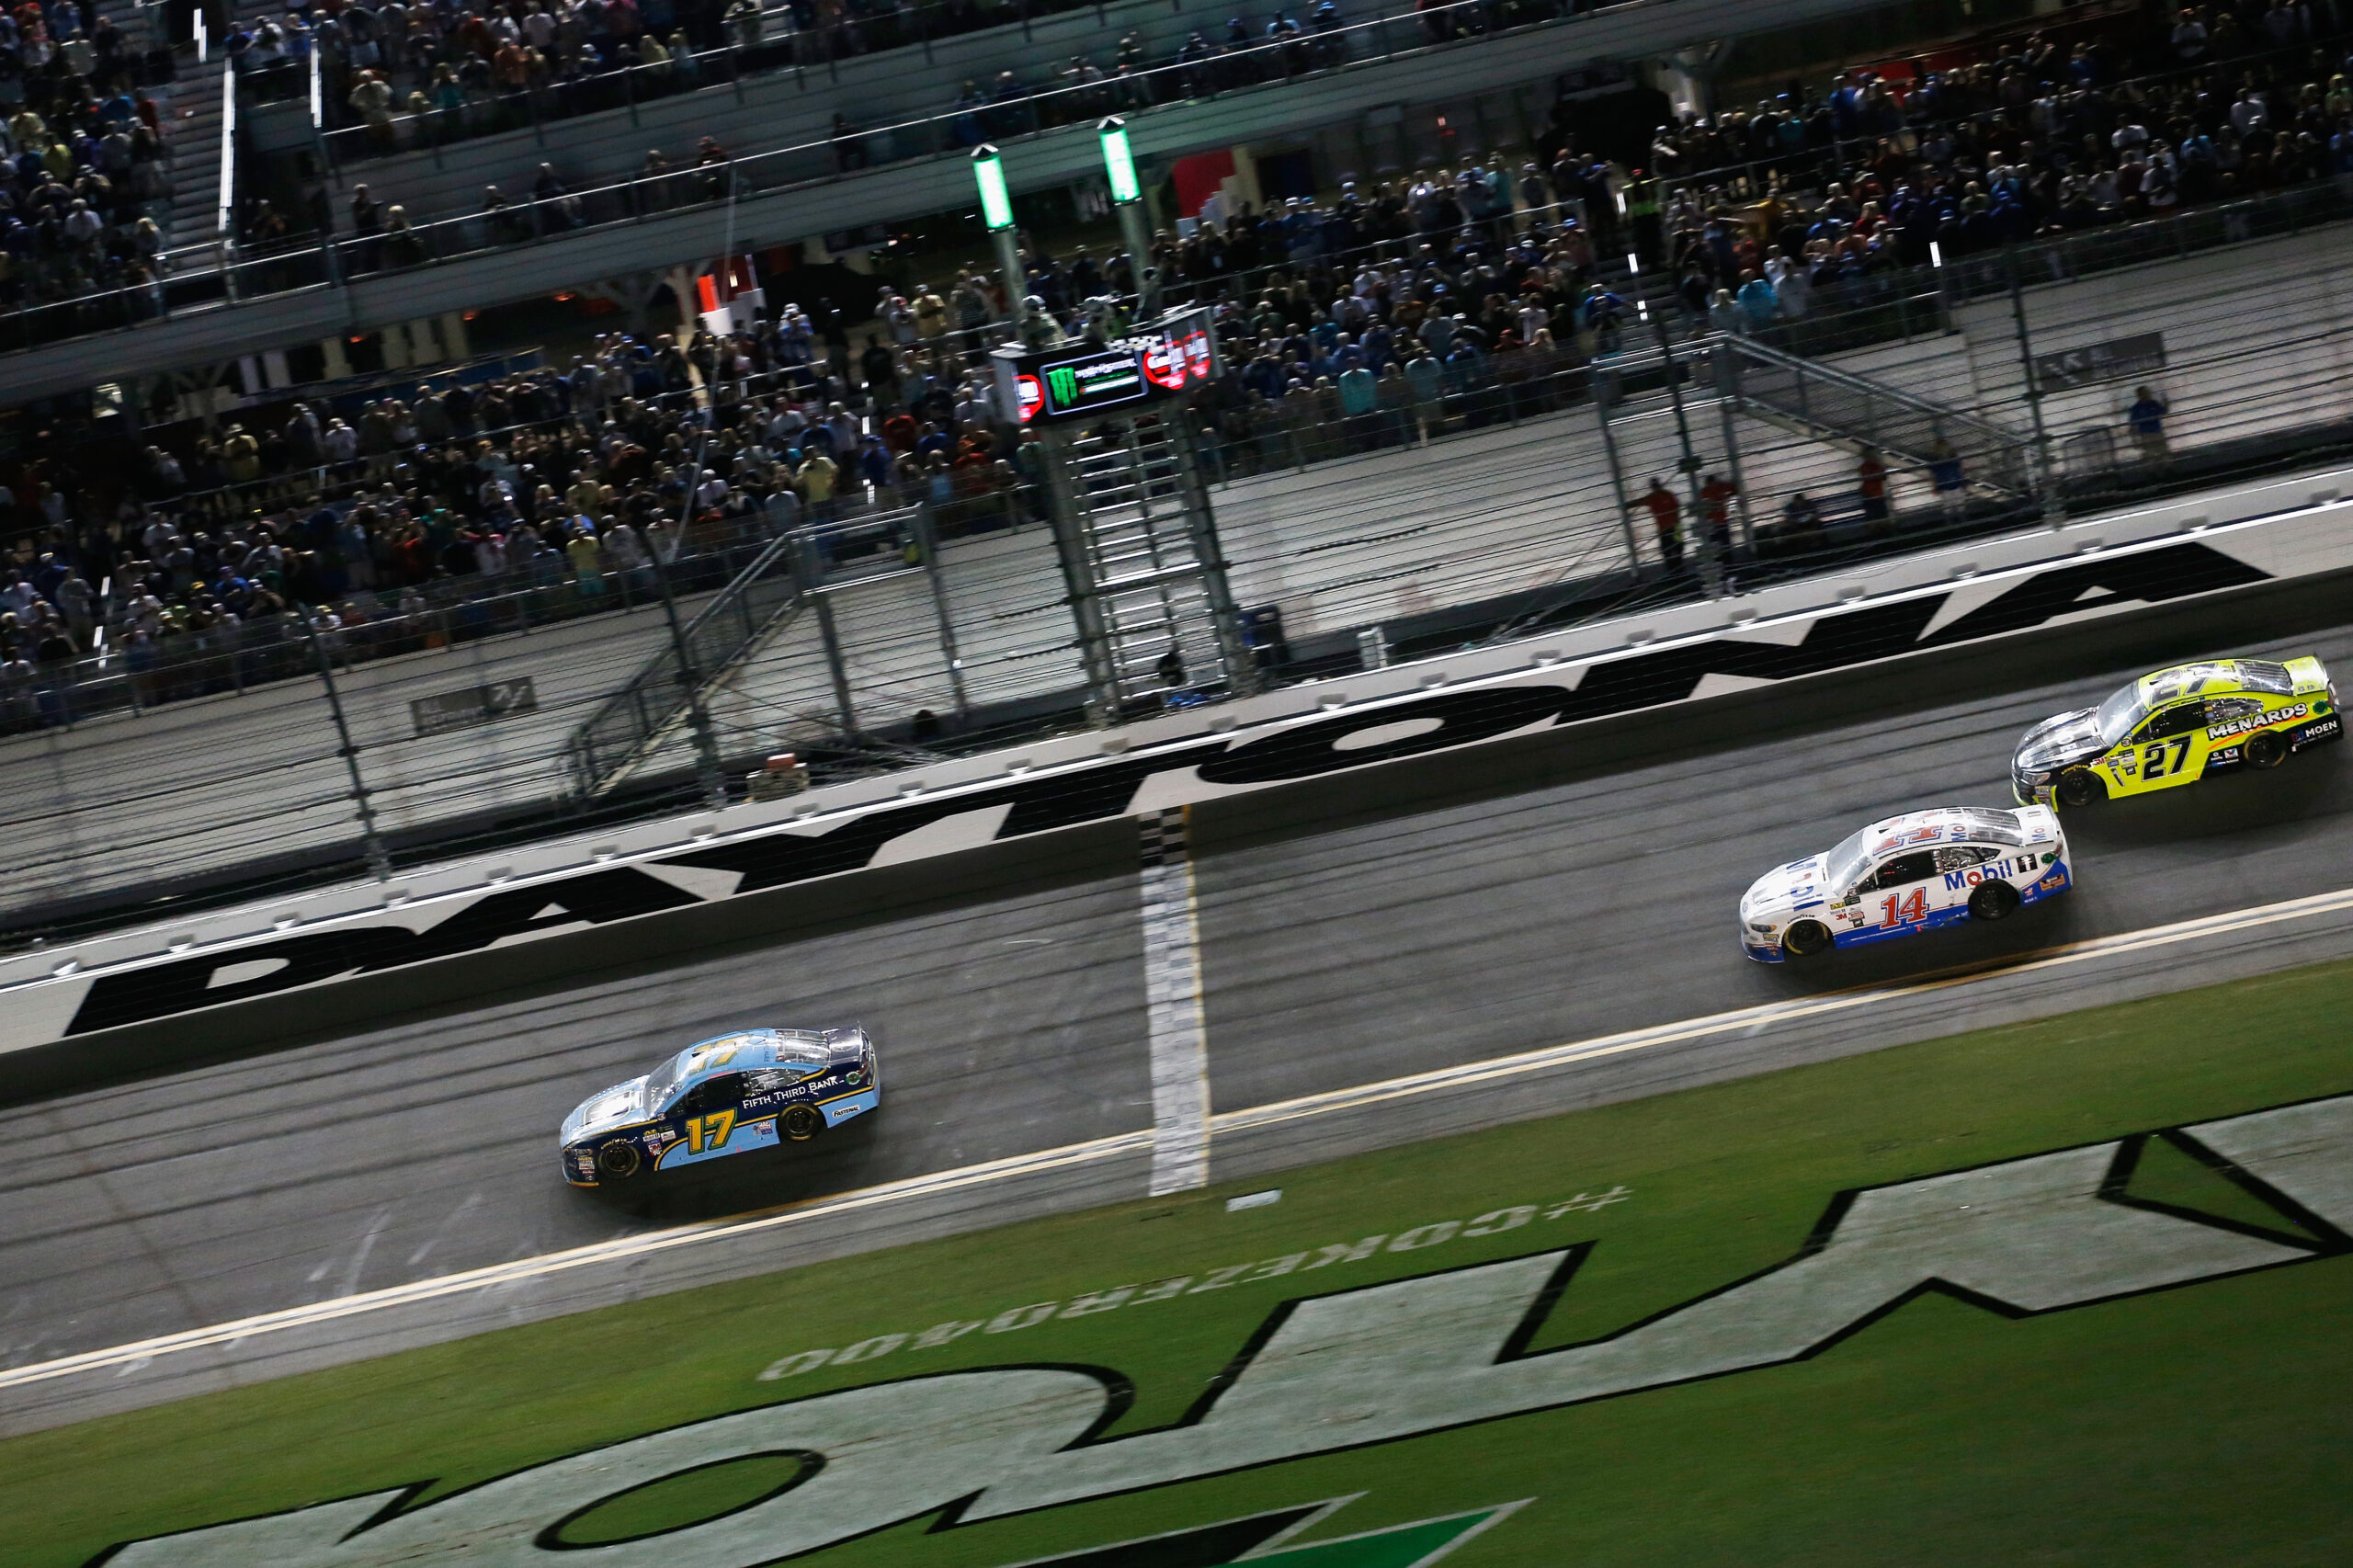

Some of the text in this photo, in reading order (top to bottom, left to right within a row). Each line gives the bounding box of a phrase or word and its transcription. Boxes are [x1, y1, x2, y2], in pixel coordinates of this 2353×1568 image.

[2207, 703, 2308, 740] MENARDS
[2305, 721, 2337, 737] MOEN
[2142, 733, 2192, 782] 27
[63, 541, 2278, 1037] DAYTONA
[1944, 858, 2013, 892] Mobil
[1880, 887, 1929, 929] 14
[743, 1096, 771, 1109] FIFTH
[774, 1086, 806, 1101] THIRD
[809, 1076, 838, 1092] BANK
[834, 1106, 859, 1118] FASTENAL
[685, 1108, 737, 1154] 17
